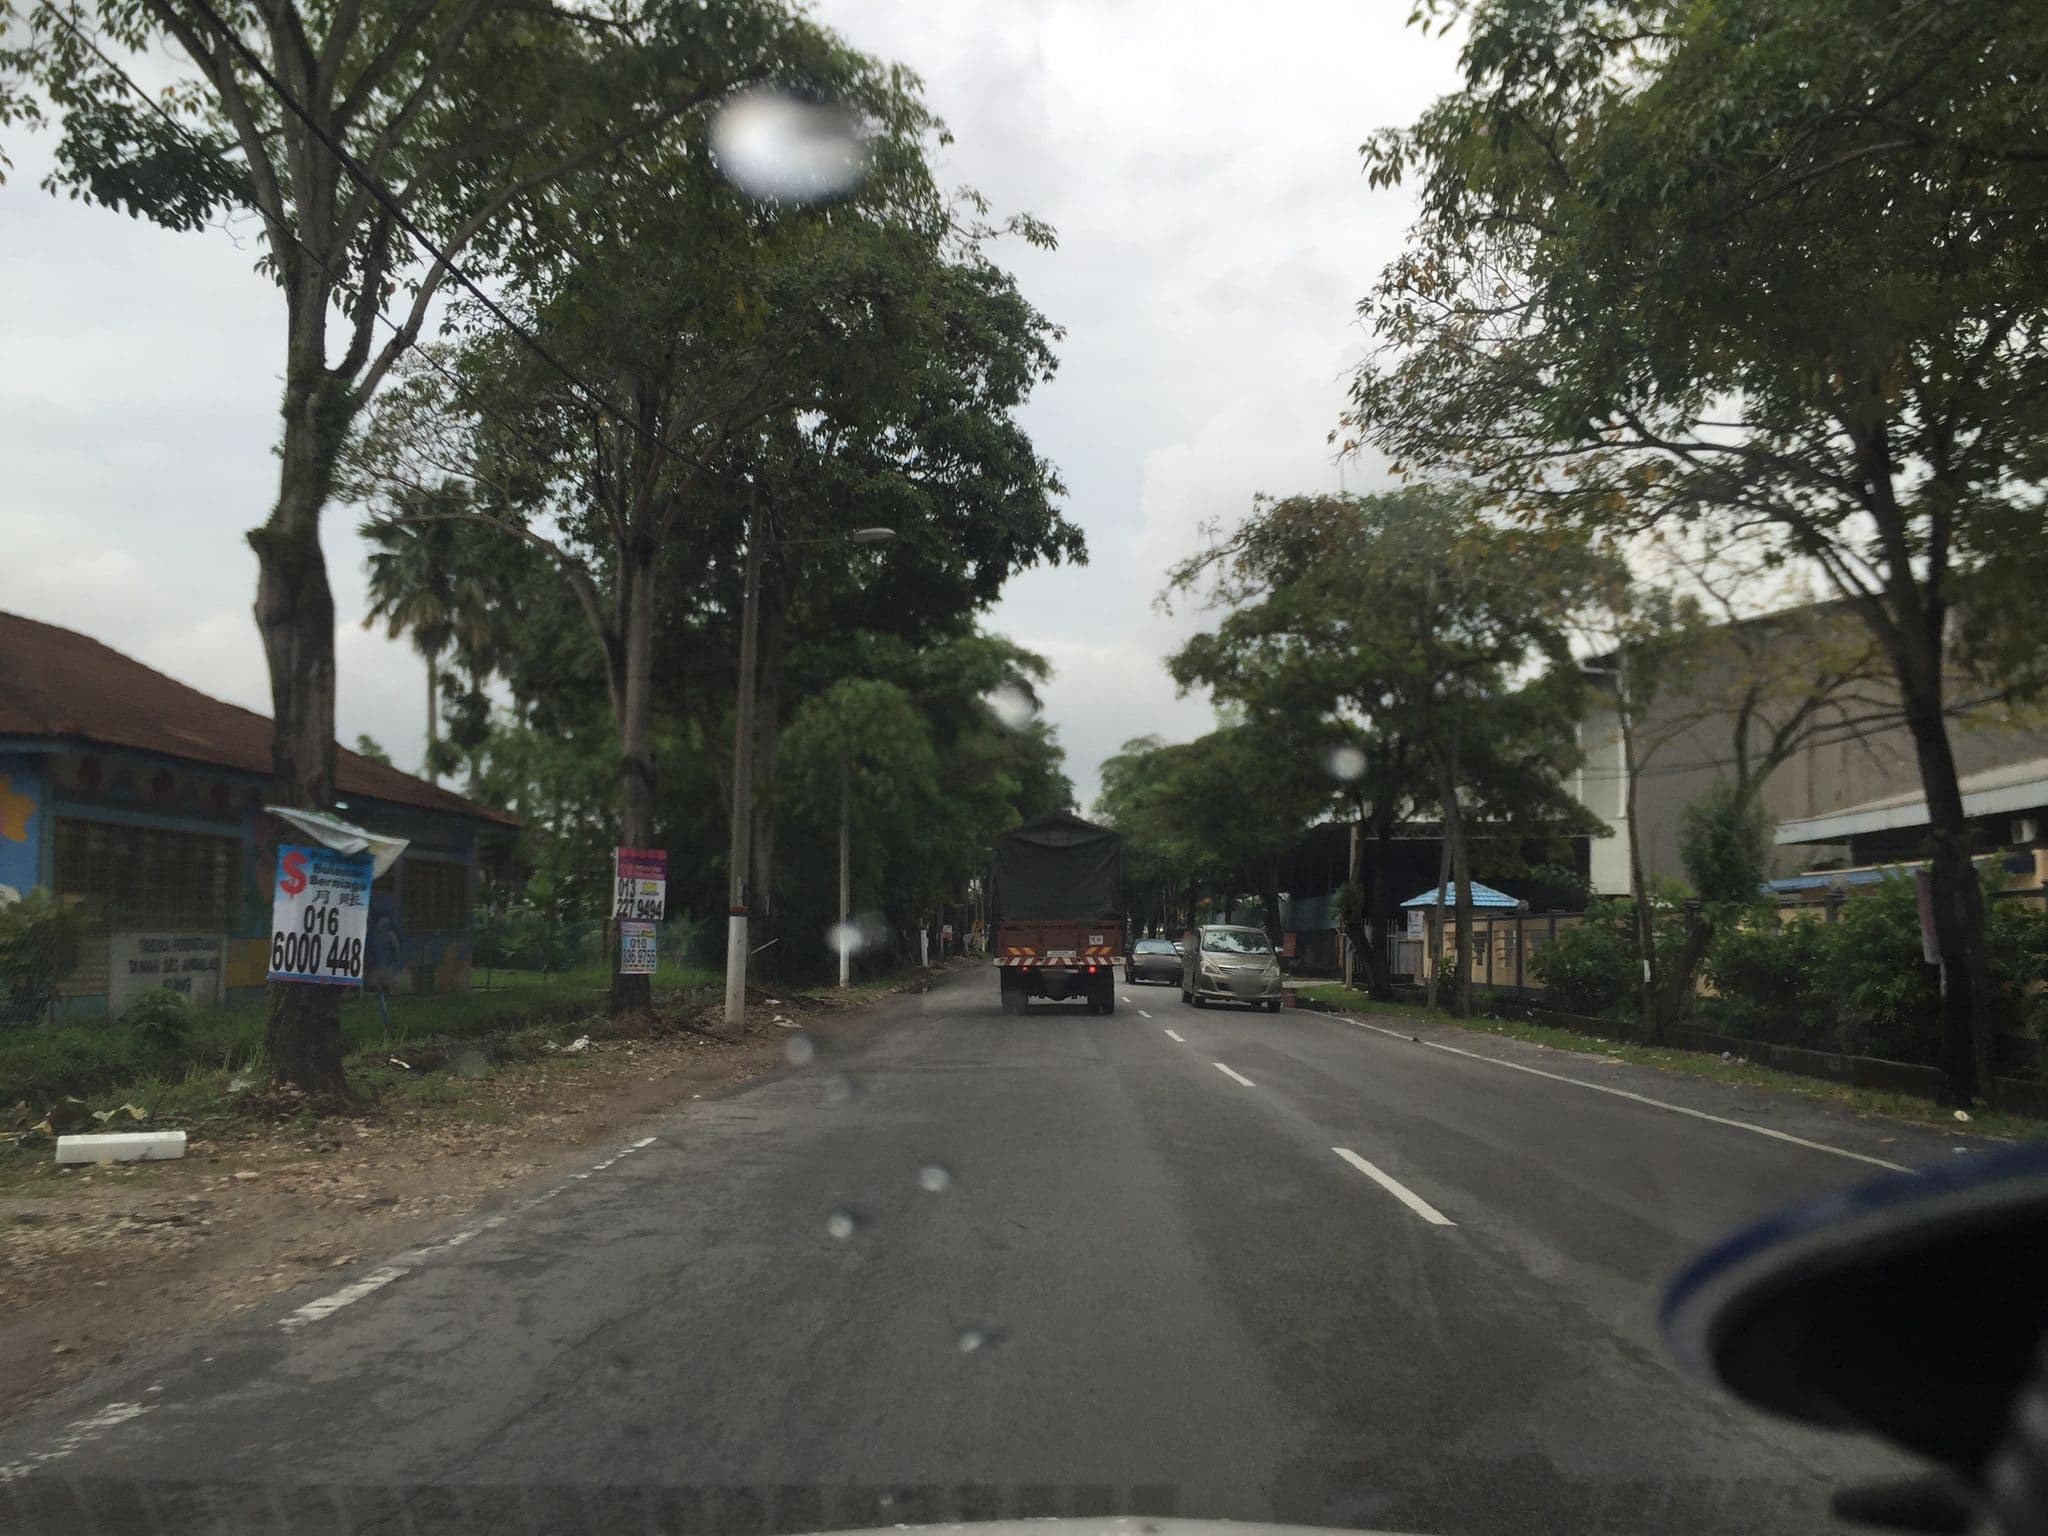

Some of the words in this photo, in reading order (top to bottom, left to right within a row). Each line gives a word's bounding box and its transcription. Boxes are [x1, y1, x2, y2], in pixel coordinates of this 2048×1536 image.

[304, 904, 339, 936] 016
[272, 931, 321, 975] 6000
[326, 936, 362, 977] 448
